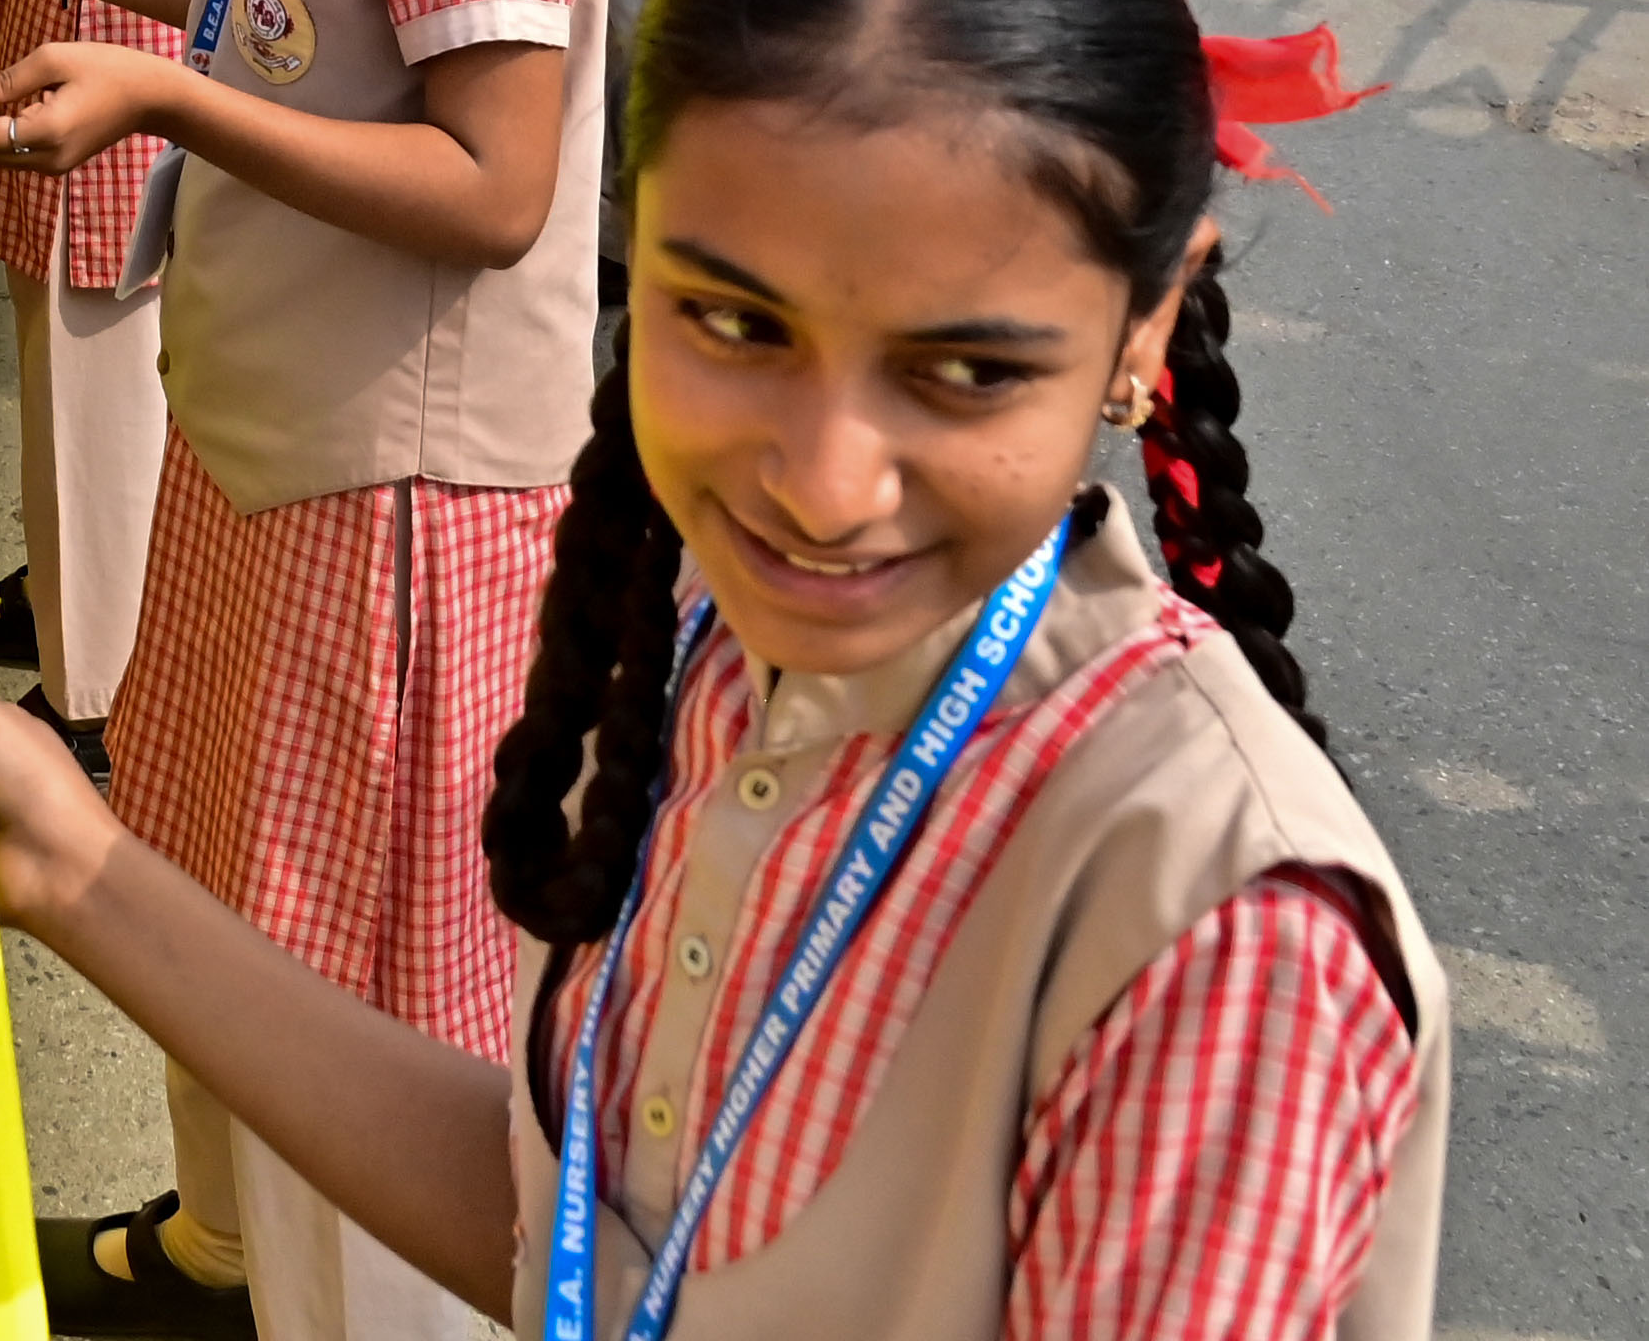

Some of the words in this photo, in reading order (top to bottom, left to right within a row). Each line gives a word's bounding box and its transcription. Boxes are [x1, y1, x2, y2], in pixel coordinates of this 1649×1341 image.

[562, 1060, 590, 1253] NURSERY
[644, 1155, 715, 1319] NURSERY
[713, 1015, 787, 1155] HIGHER
[780, 847, 869, 1016] PRIMARY
[871, 769, 924, 855] AND
[919, 670, 987, 769] HIGH
